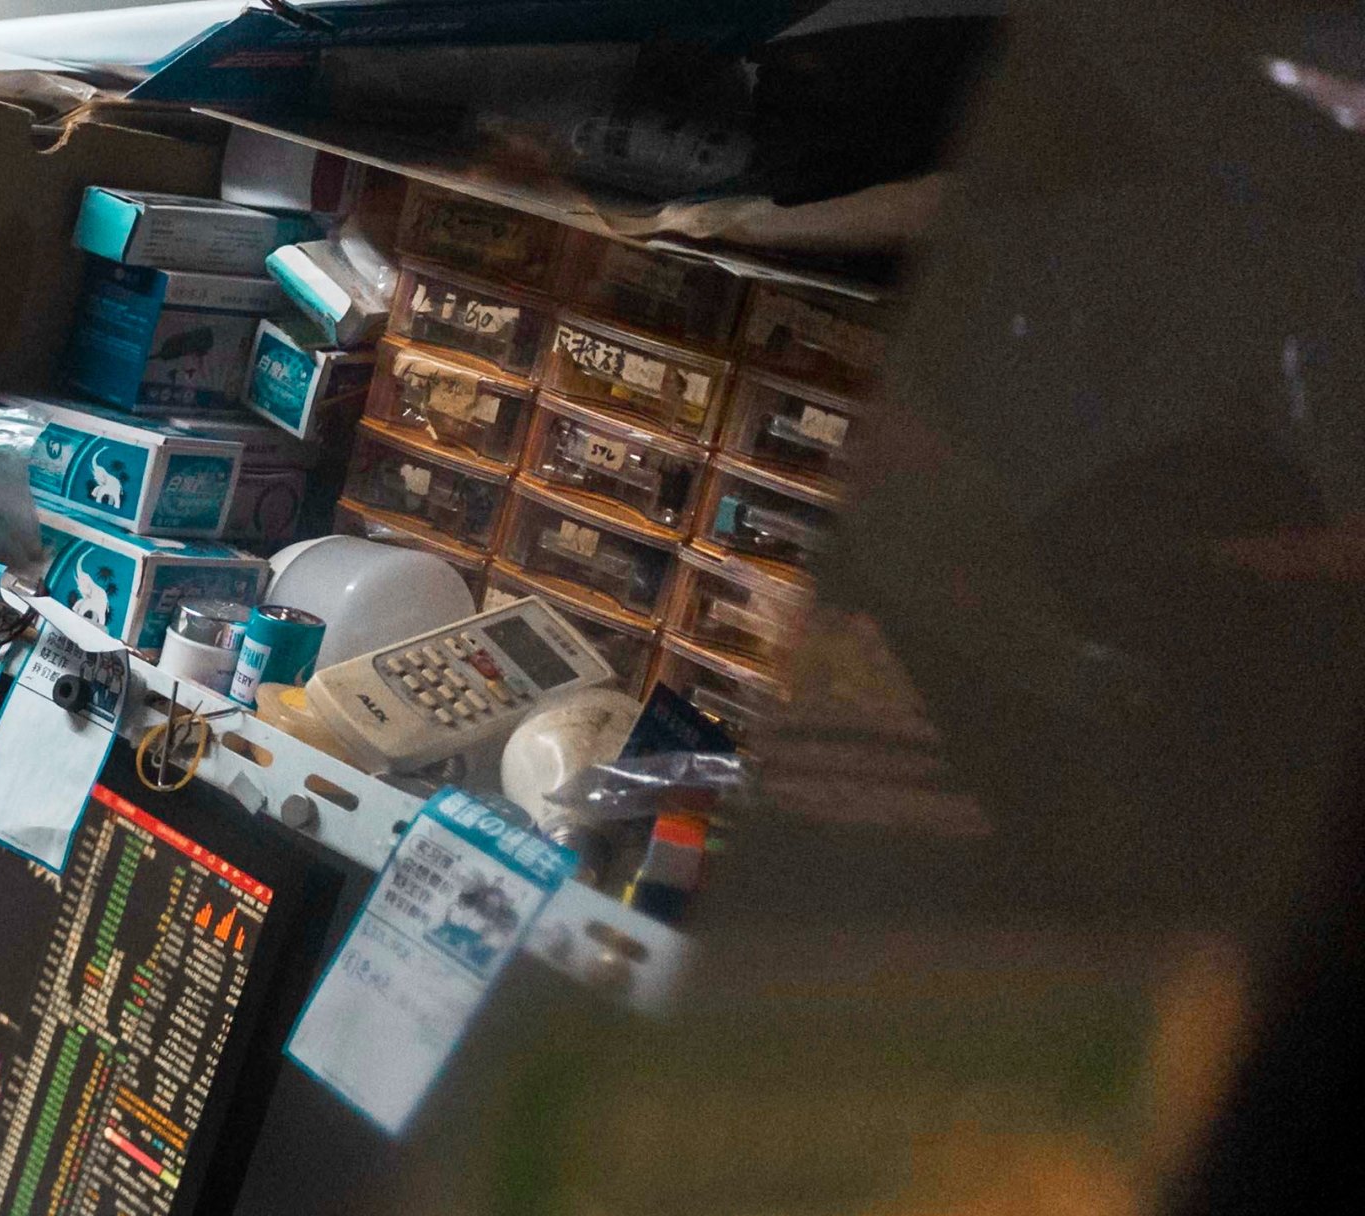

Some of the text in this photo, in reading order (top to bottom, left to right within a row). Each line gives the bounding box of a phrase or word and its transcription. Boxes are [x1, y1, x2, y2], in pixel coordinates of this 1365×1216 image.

[31, 662, 61, 682] 我们都
[356, 693, 390, 723] AUX
